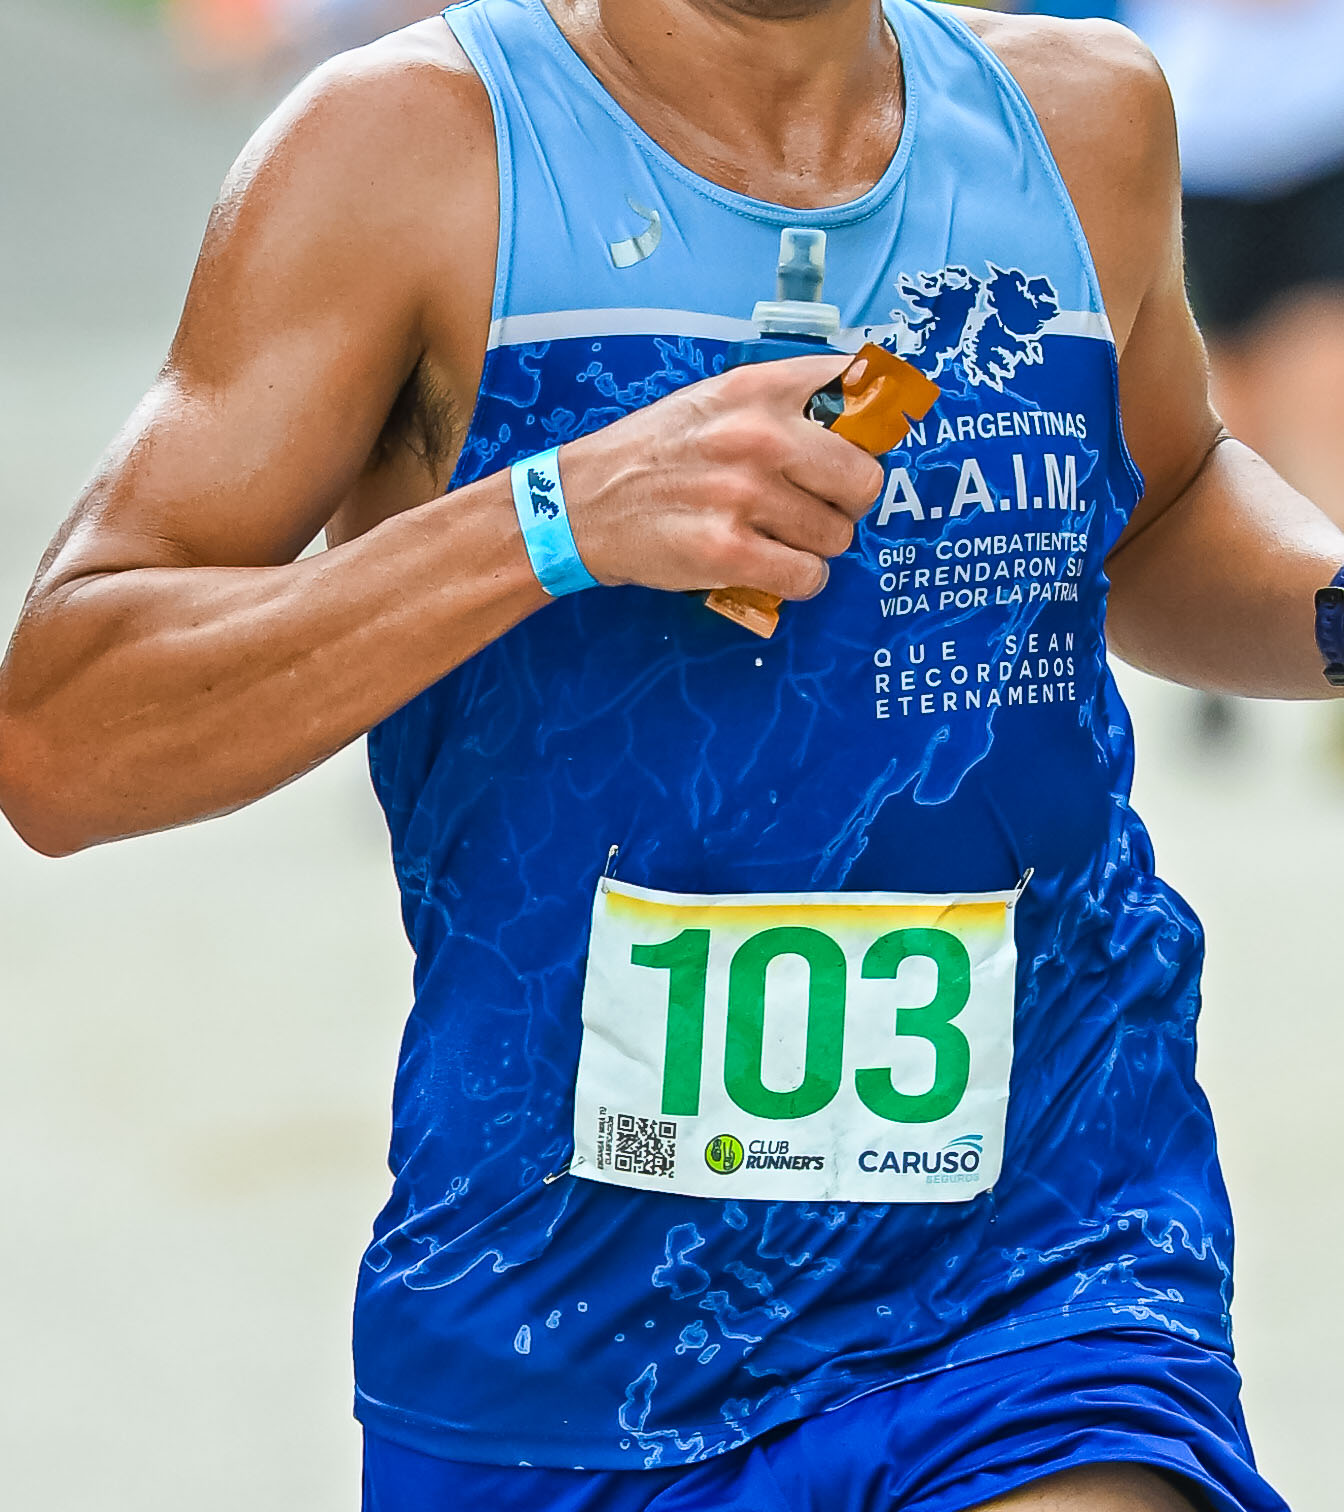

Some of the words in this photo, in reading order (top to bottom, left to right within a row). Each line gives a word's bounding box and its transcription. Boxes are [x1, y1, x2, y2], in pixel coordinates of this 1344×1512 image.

[936, 410, 1087, 444] ARGENTINAS
[876, 453, 1086, 526] A.A.I.M.
[878, 545, 916, 568] 649
[935, 532, 1088, 560] COMBATIENTES
[879, 556, 1056, 592] OFRENDARON
[880, 593, 930, 618] VIDA
[939, 587, 989, 611] POR
[995, 584, 1023, 605] LA
[1028, 581, 1079, 603] PATRIA
[873, 640, 957, 668] QUE
[1005, 632, 1074, 655] SEAN
[875, 656, 1075, 694] RECORDADOS
[875, 681, 1076, 719] ETERNAMENTE
[629, 925, 972, 1124] 103
[745, 1155, 825, 1171] RUNNER'S
[748, 1139, 790, 1155] CLUB
[858, 1149, 981, 1175] CARUSO
